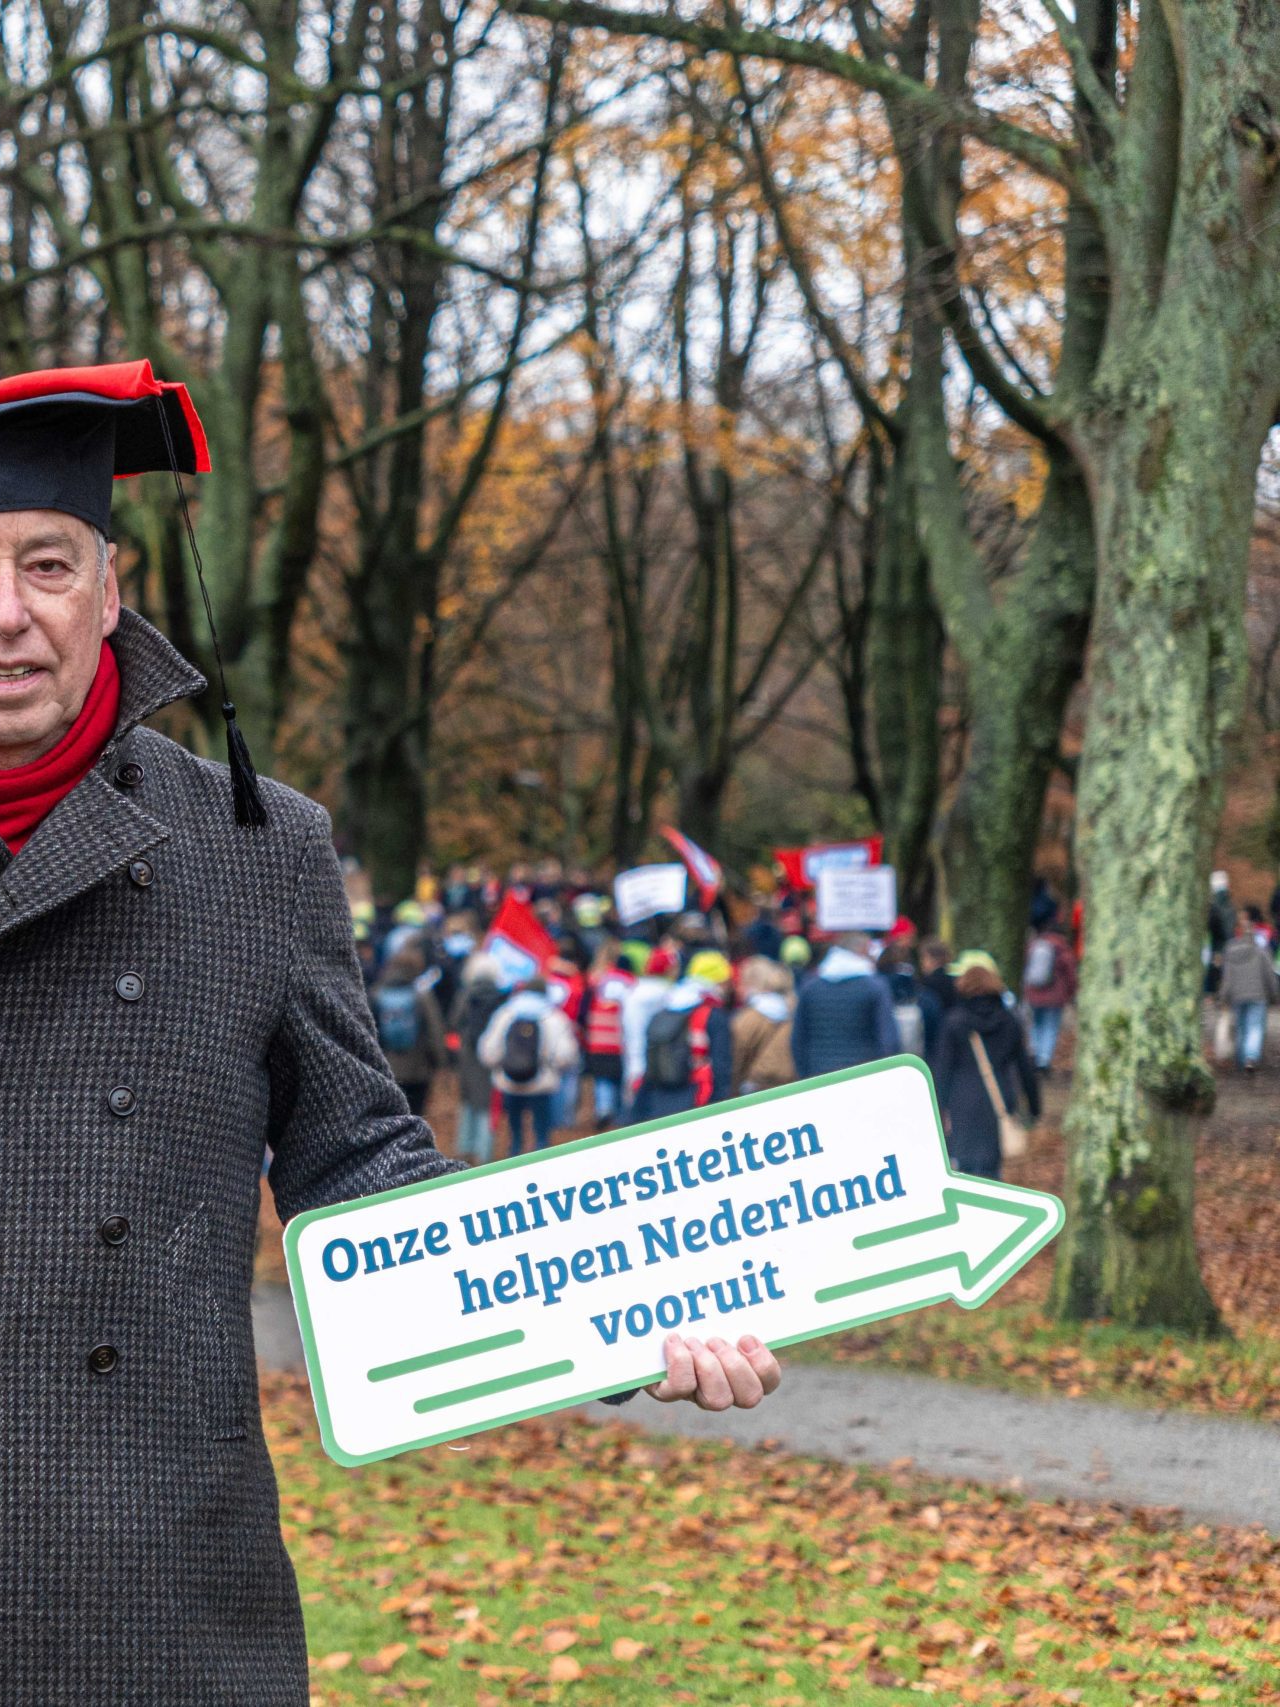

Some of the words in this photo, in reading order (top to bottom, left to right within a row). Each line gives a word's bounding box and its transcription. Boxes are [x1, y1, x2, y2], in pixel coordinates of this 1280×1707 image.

[323, 1221, 450, 1281] Onze
[460, 1122, 823, 1246] universiteiten
[454, 1240, 633, 1315] helpen
[640, 1155, 906, 1265] Nederland
[591, 1259, 785, 1345] vooruit
